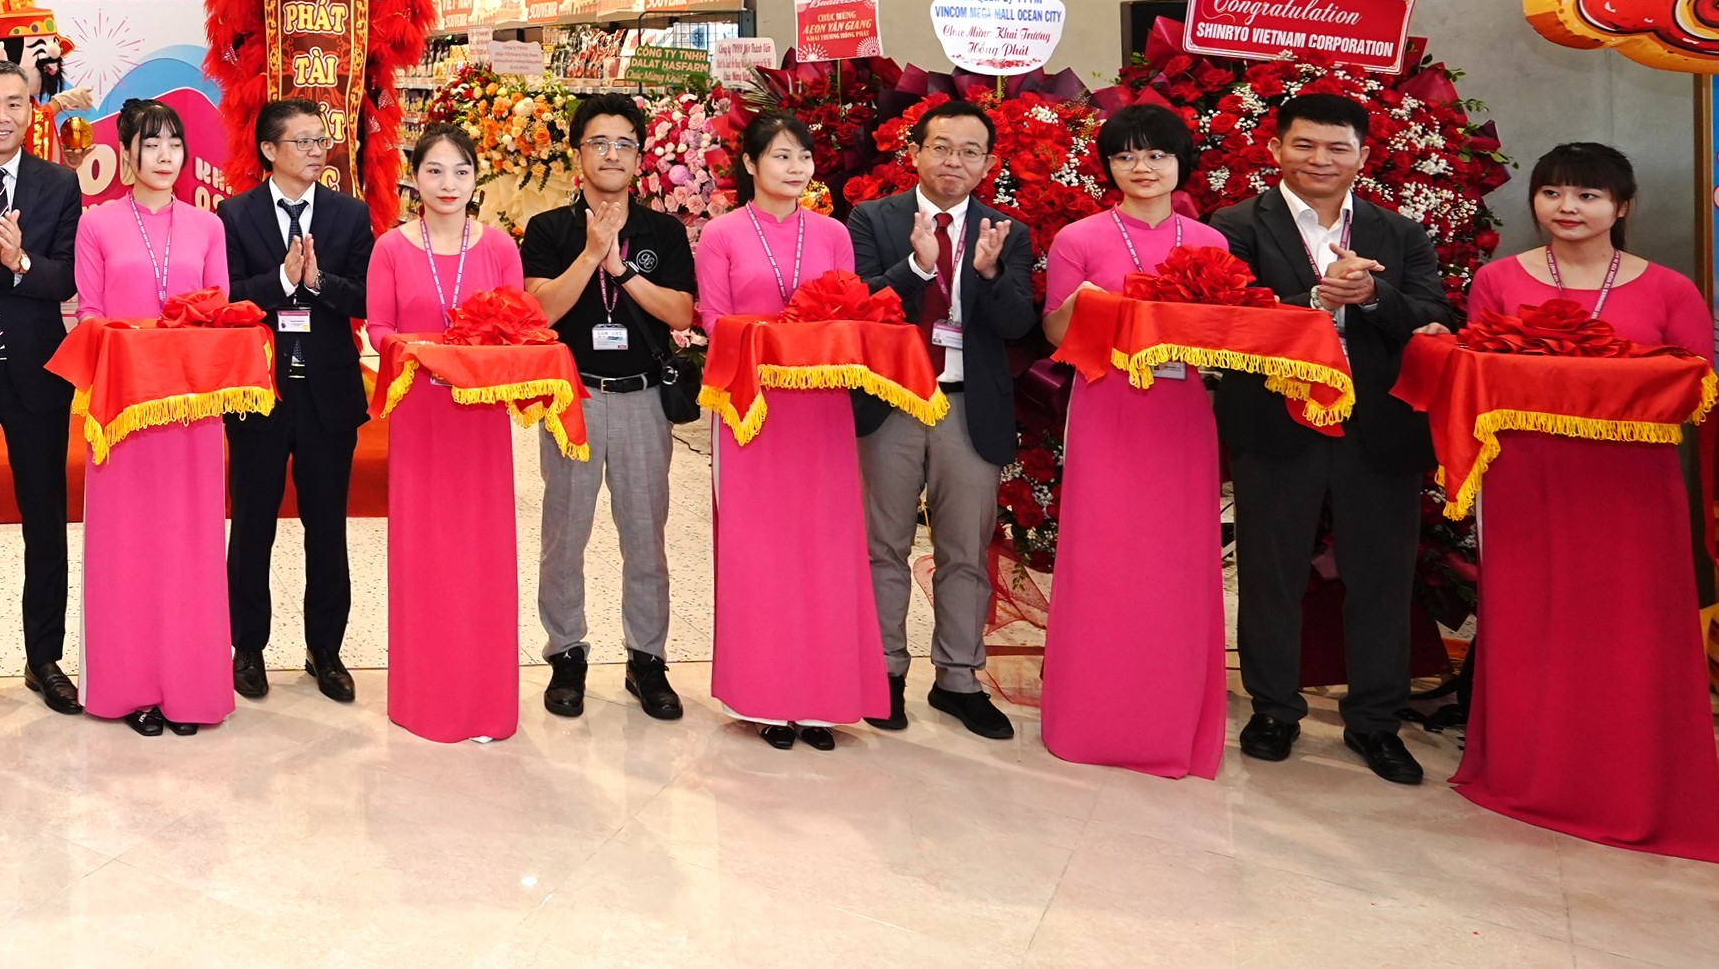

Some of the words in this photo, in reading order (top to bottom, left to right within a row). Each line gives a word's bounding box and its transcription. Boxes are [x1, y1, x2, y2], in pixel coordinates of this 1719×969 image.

[934, 5, 967, 18] VINCOM
[970, 7, 992, 19] MEGA
[994, 8, 1015, 21] MALL
[1017, 9, 1043, 22] OCEAN
[1044, 10, 1062, 23] CITY
[845, 19, 873, 30] GIANG
[995, 26, 1018, 39] Khai
[1196, 22, 1249, 43] SHINRYO
[1251, 28, 1306, 49] VIETNAM
[1308, 34, 1395, 58] CORPORATION
[636, 45, 663, 58] CÔNG
[665, 49, 678, 59] TY
[679, 50, 707, 61] TNHH
[293, 46, 339, 87] TÀI
[631, 57, 661, 68] DALAT
[662, 61, 710, 72] HASFARM
